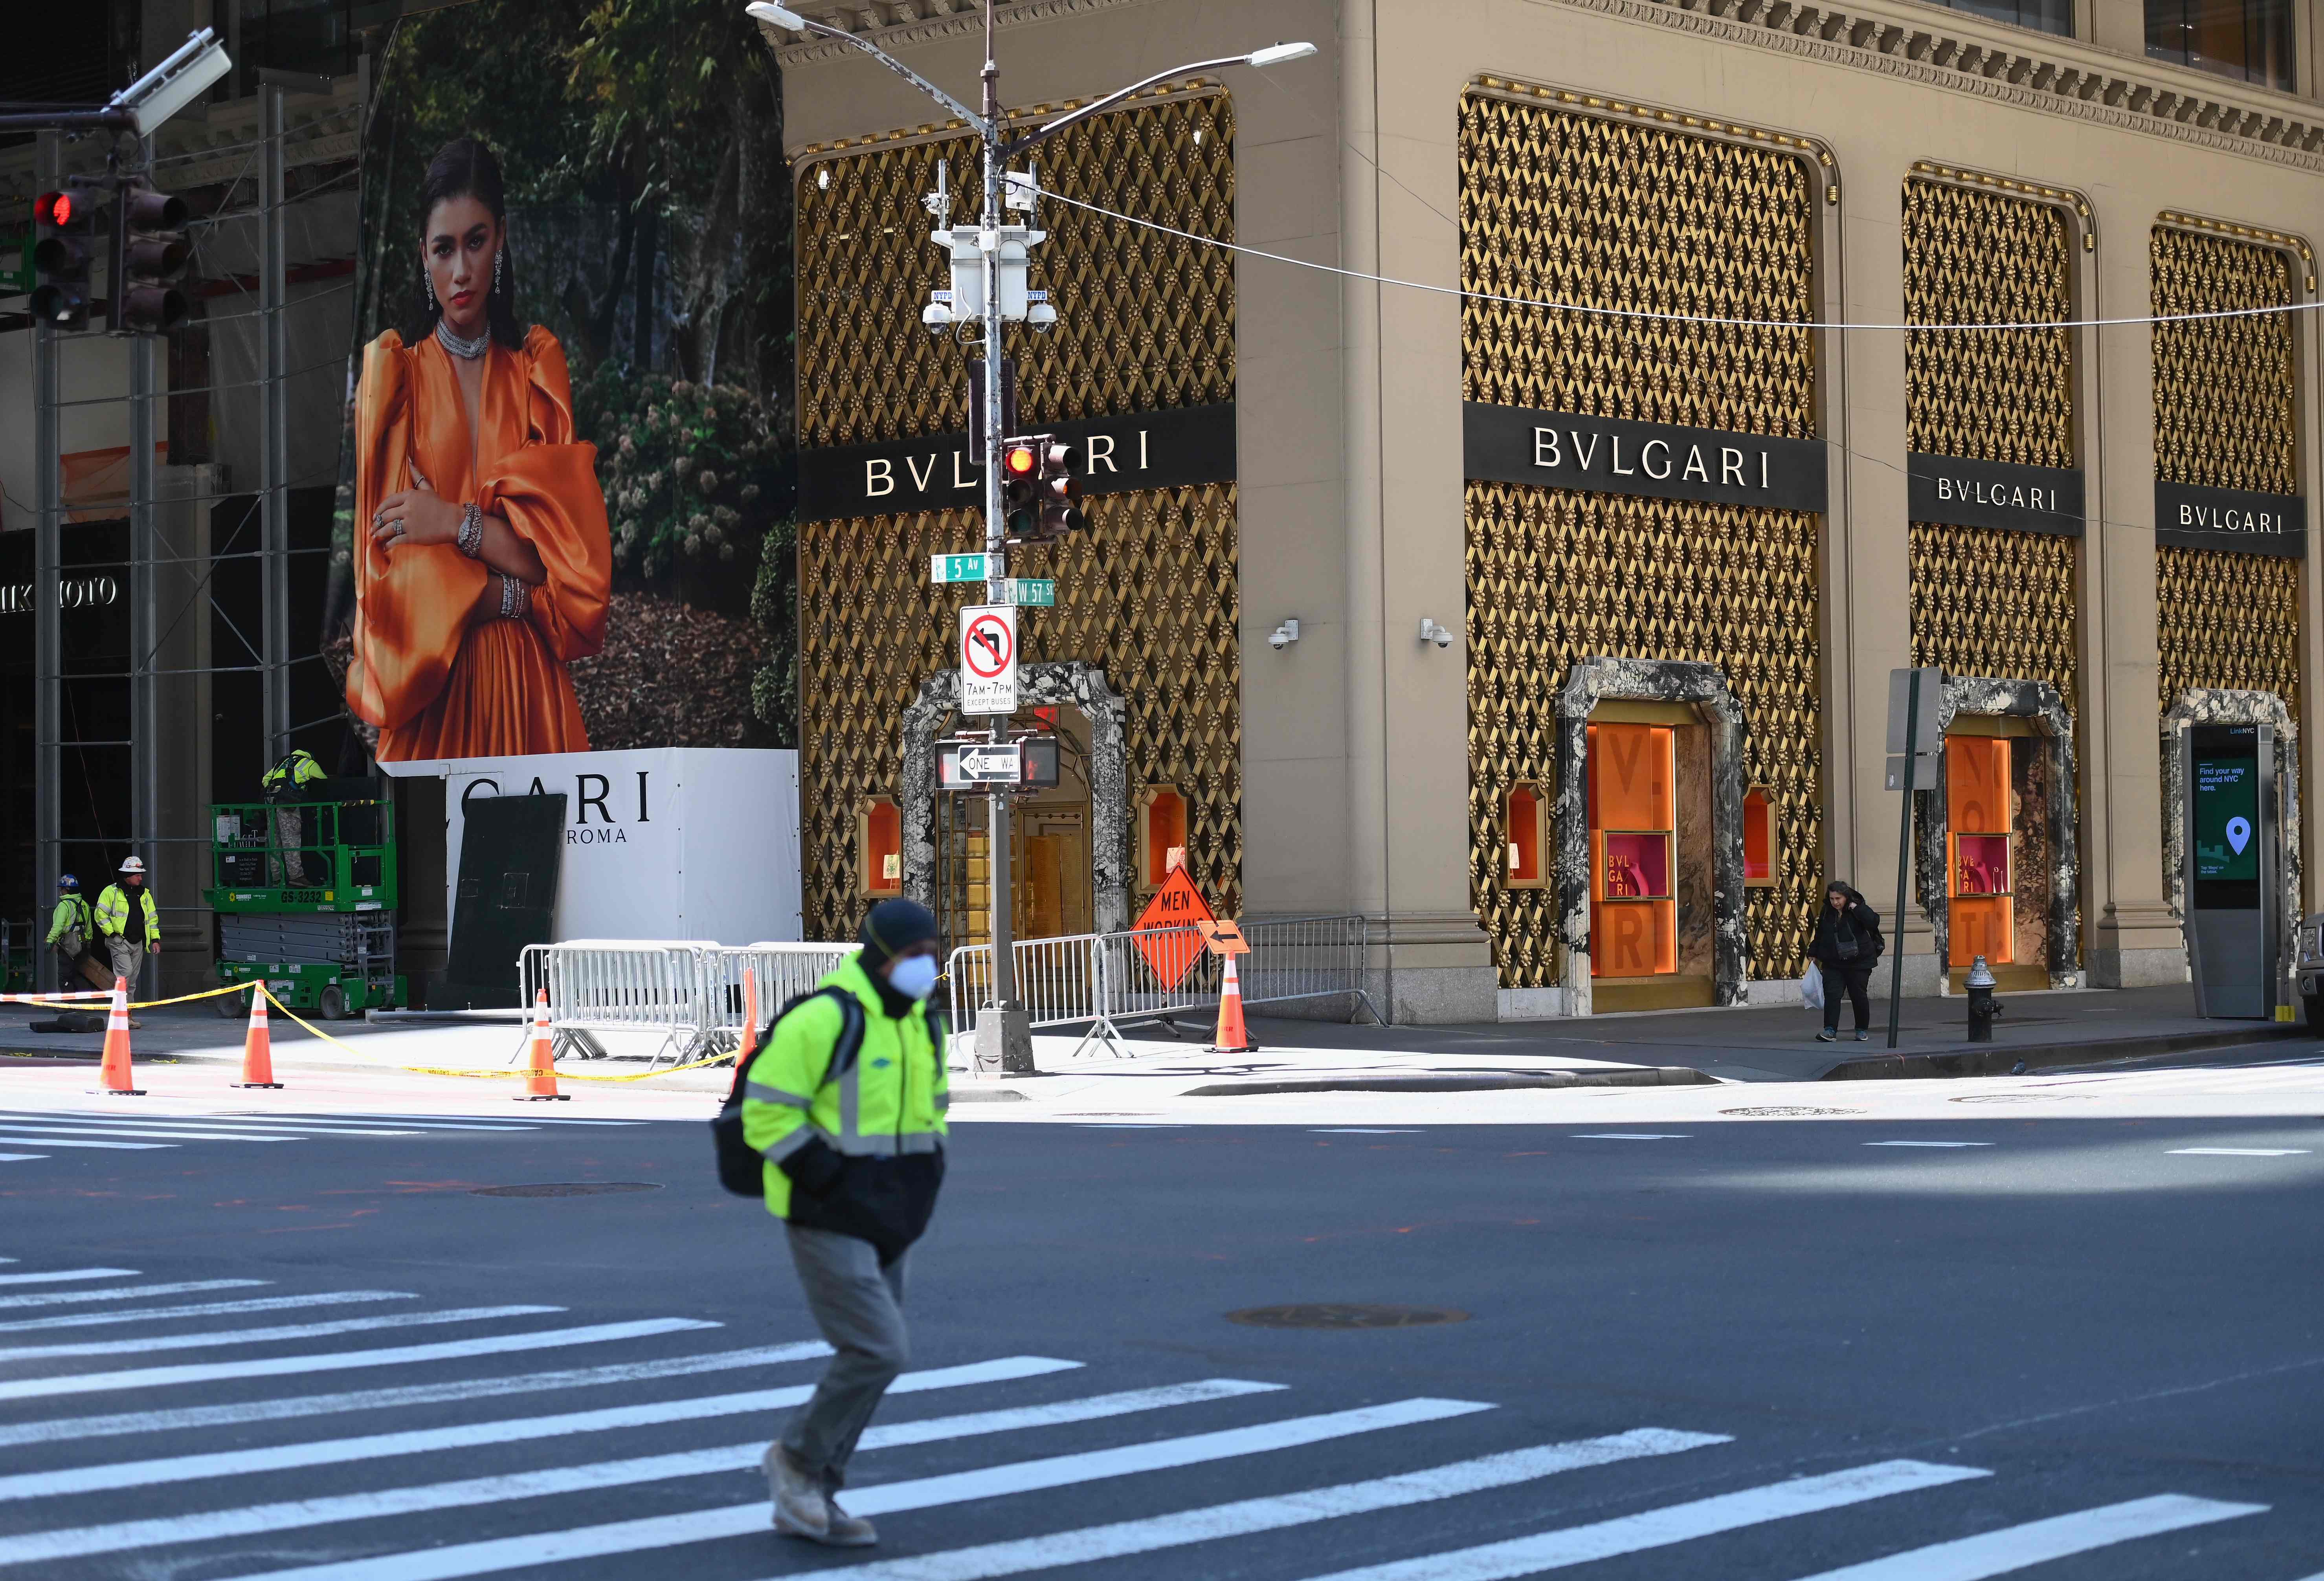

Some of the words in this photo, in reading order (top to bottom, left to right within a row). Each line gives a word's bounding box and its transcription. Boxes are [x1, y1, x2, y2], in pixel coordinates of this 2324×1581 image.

[866, 430, 1149, 497] BVLRI
[1533, 427, 1769, 488] BVLGARI
[1938, 478, 2056, 511] BVLGARI
[2180, 504, 2282, 535] BVLGARI
[954, 558, 962, 579] 5
[967, 558, 978, 570] Av
[1018, 583, 1027, 602] W
[1032, 583, 1042, 603] 57
[1046, 583, 1053, 596] St
[969, 757, 989, 770] ONE
[1001, 757, 1013, 769] WA
[567, 827, 627, 845] ROMA
[1609, 855, 1629, 868] BVL
[1608, 870, 1623, 882] GA
[1617, 883, 1628, 896] RI
[1964, 881, 1973, 893] RI
[281, 891, 321, 903] GS-3232
[1161, 891, 1190, 912] MEN
